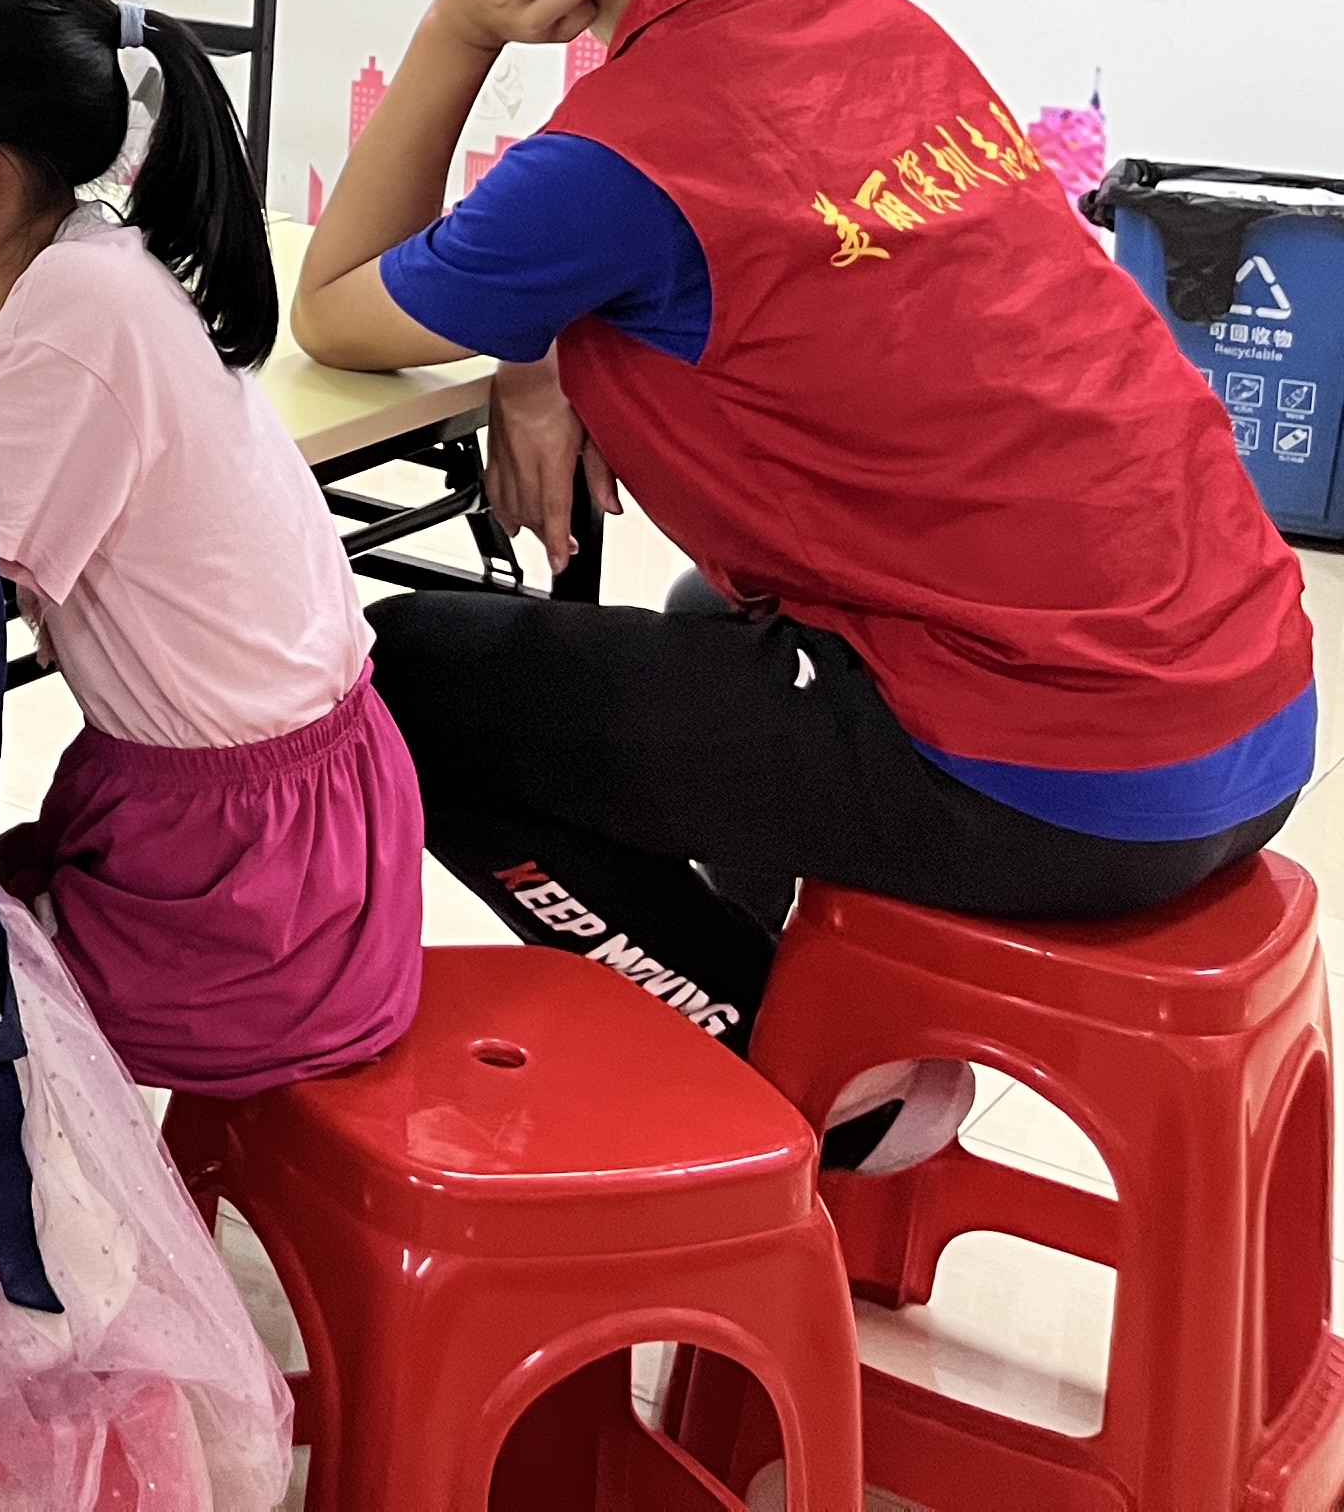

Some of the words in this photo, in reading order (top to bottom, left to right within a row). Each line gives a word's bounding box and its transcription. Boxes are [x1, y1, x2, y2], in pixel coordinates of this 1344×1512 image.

[1210, 321, 1293, 349] 可回收物
[1214, 342, 1284, 362] Recyclable
[492, 859, 607, 938] KEEP
